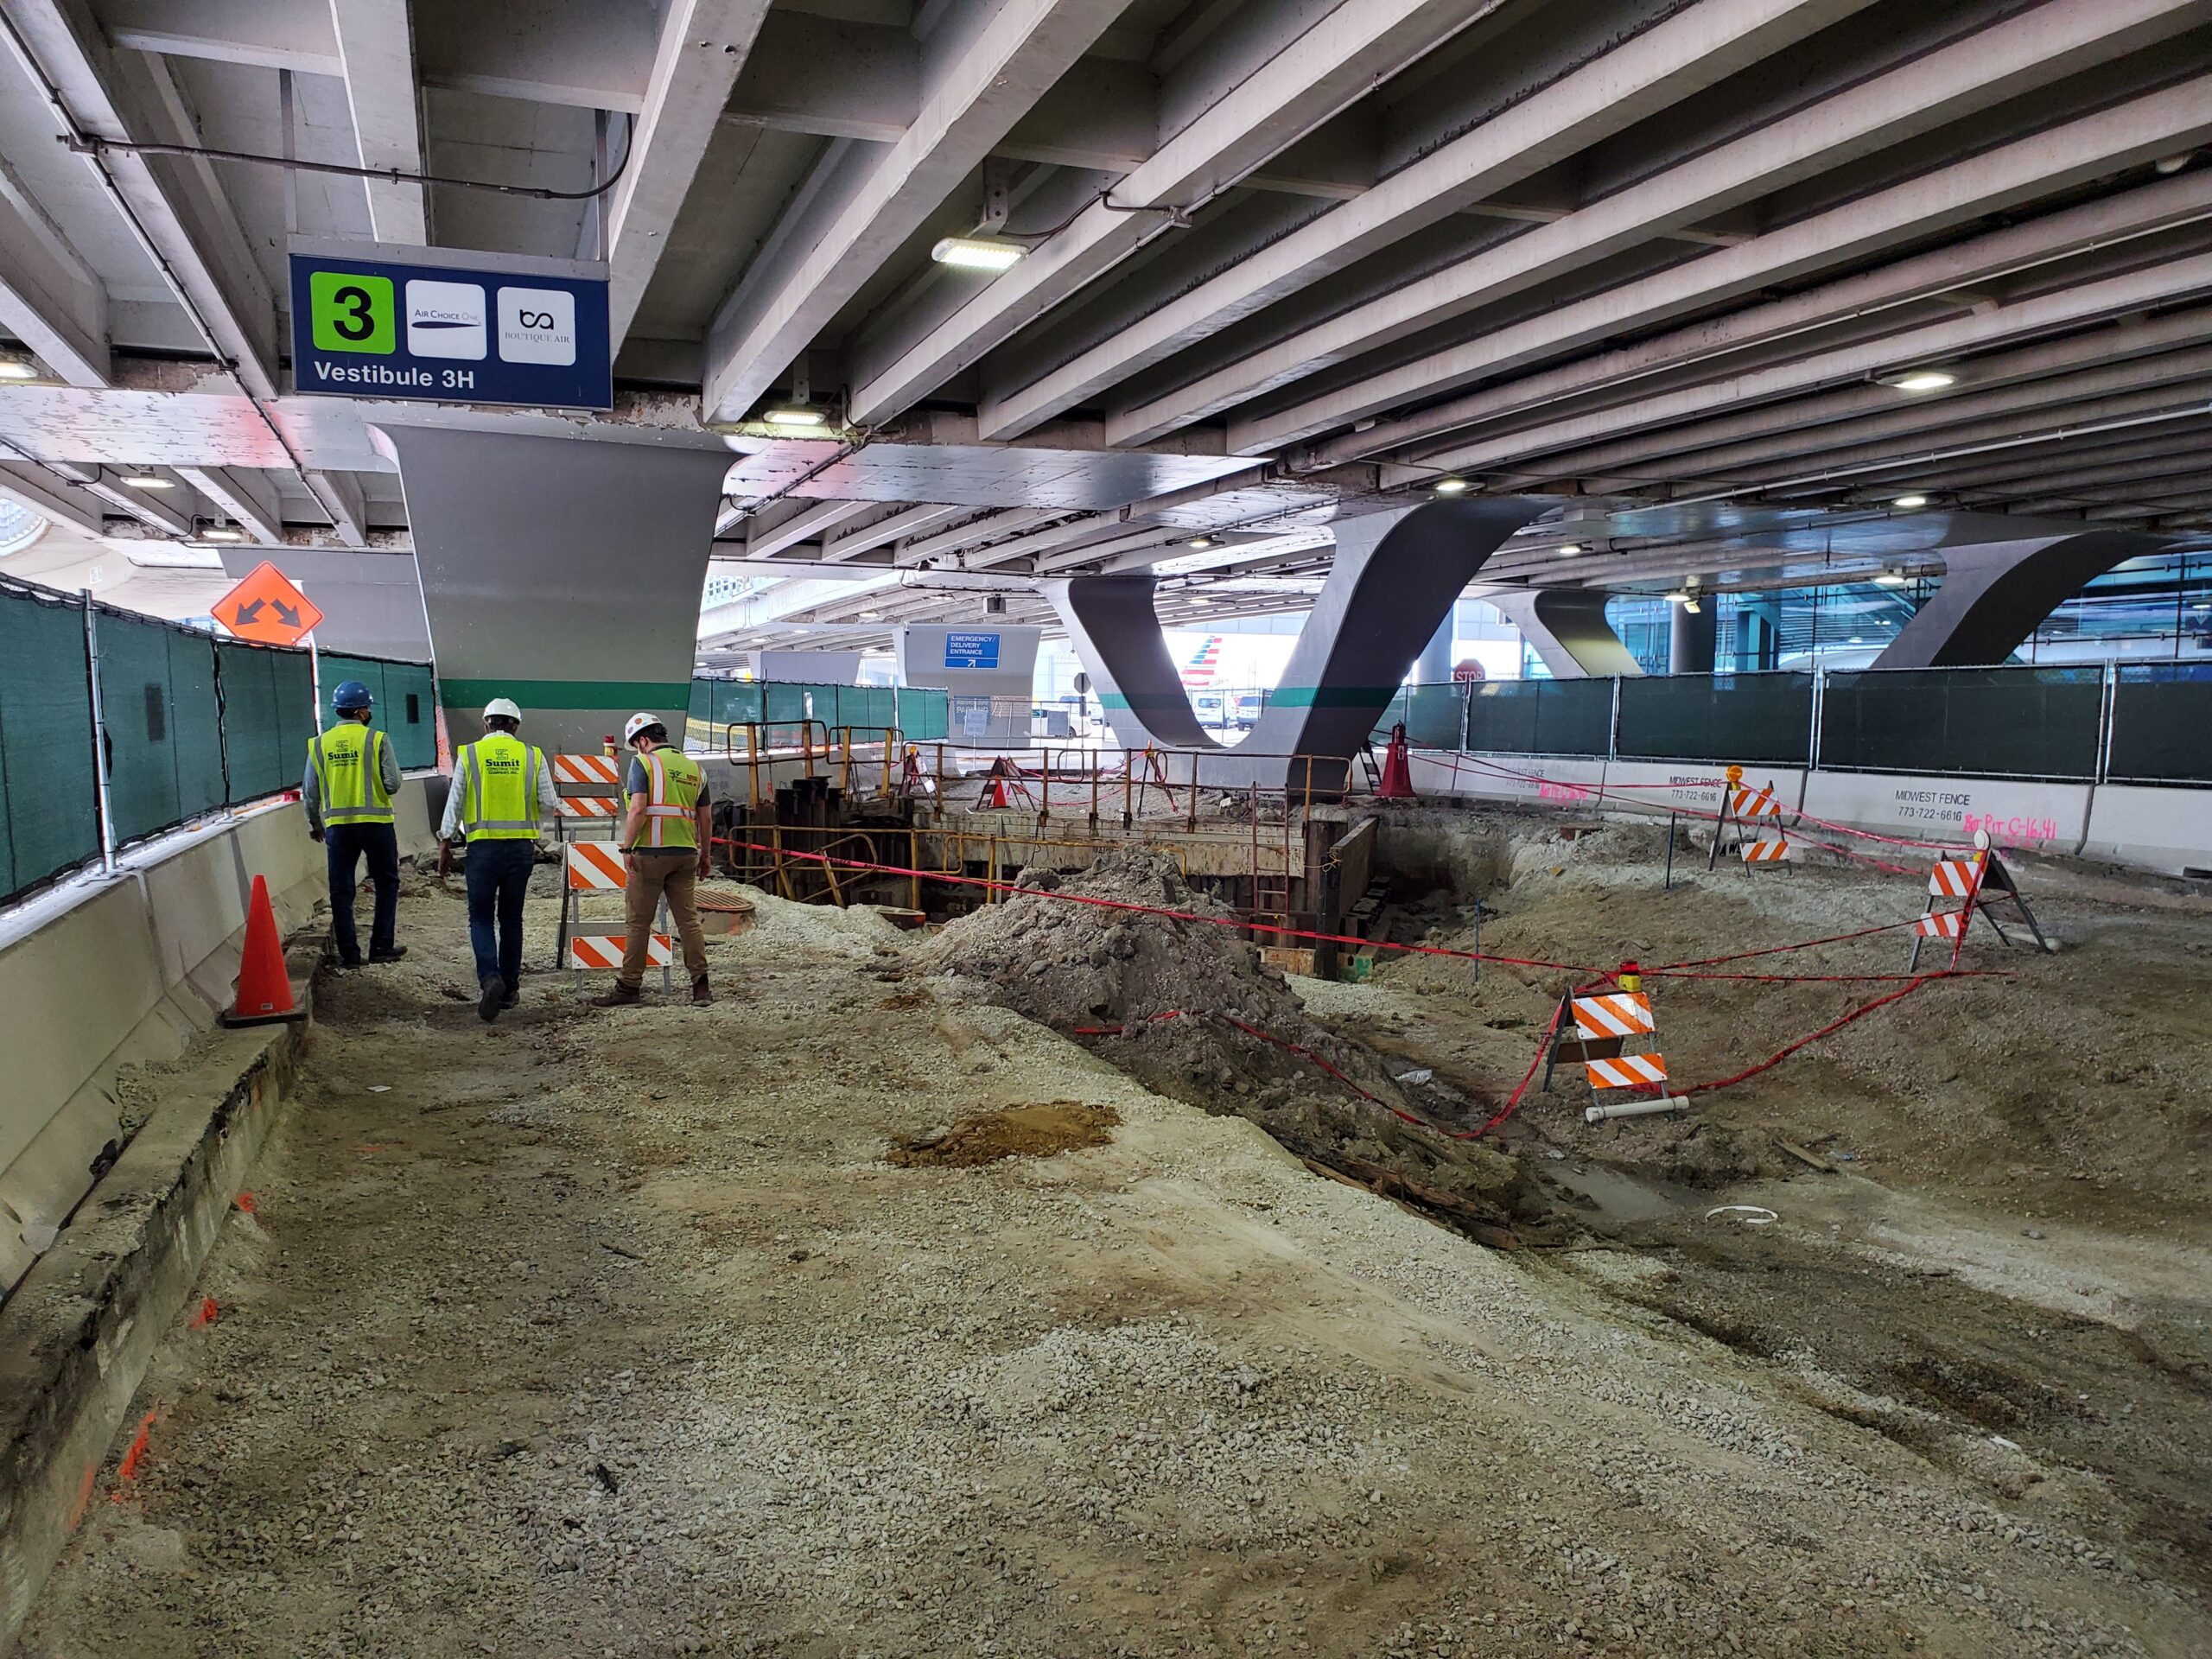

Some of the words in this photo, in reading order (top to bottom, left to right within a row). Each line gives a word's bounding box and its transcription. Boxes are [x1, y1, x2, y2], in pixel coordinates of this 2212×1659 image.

[333, 286, 375, 340] 3
[505, 332, 552, 343] BOUTIQUE
[314, 360, 433, 387] Vestibule
[442, 370, 474, 390] 3H
[1456, 671, 1483, 681] STOP
[327, 750, 359, 760] Sumit
[1669, 776, 1699, 785] MIDWEST
[1700, 779, 1722, 788] FENCE
[1671, 790, 1717, 802] 773-722-6616
[1895, 790, 1937, 804] MIDWEST
[1939, 792, 1971, 806] FENCE
[1898, 806, 1962, 822] 773-722-6616
